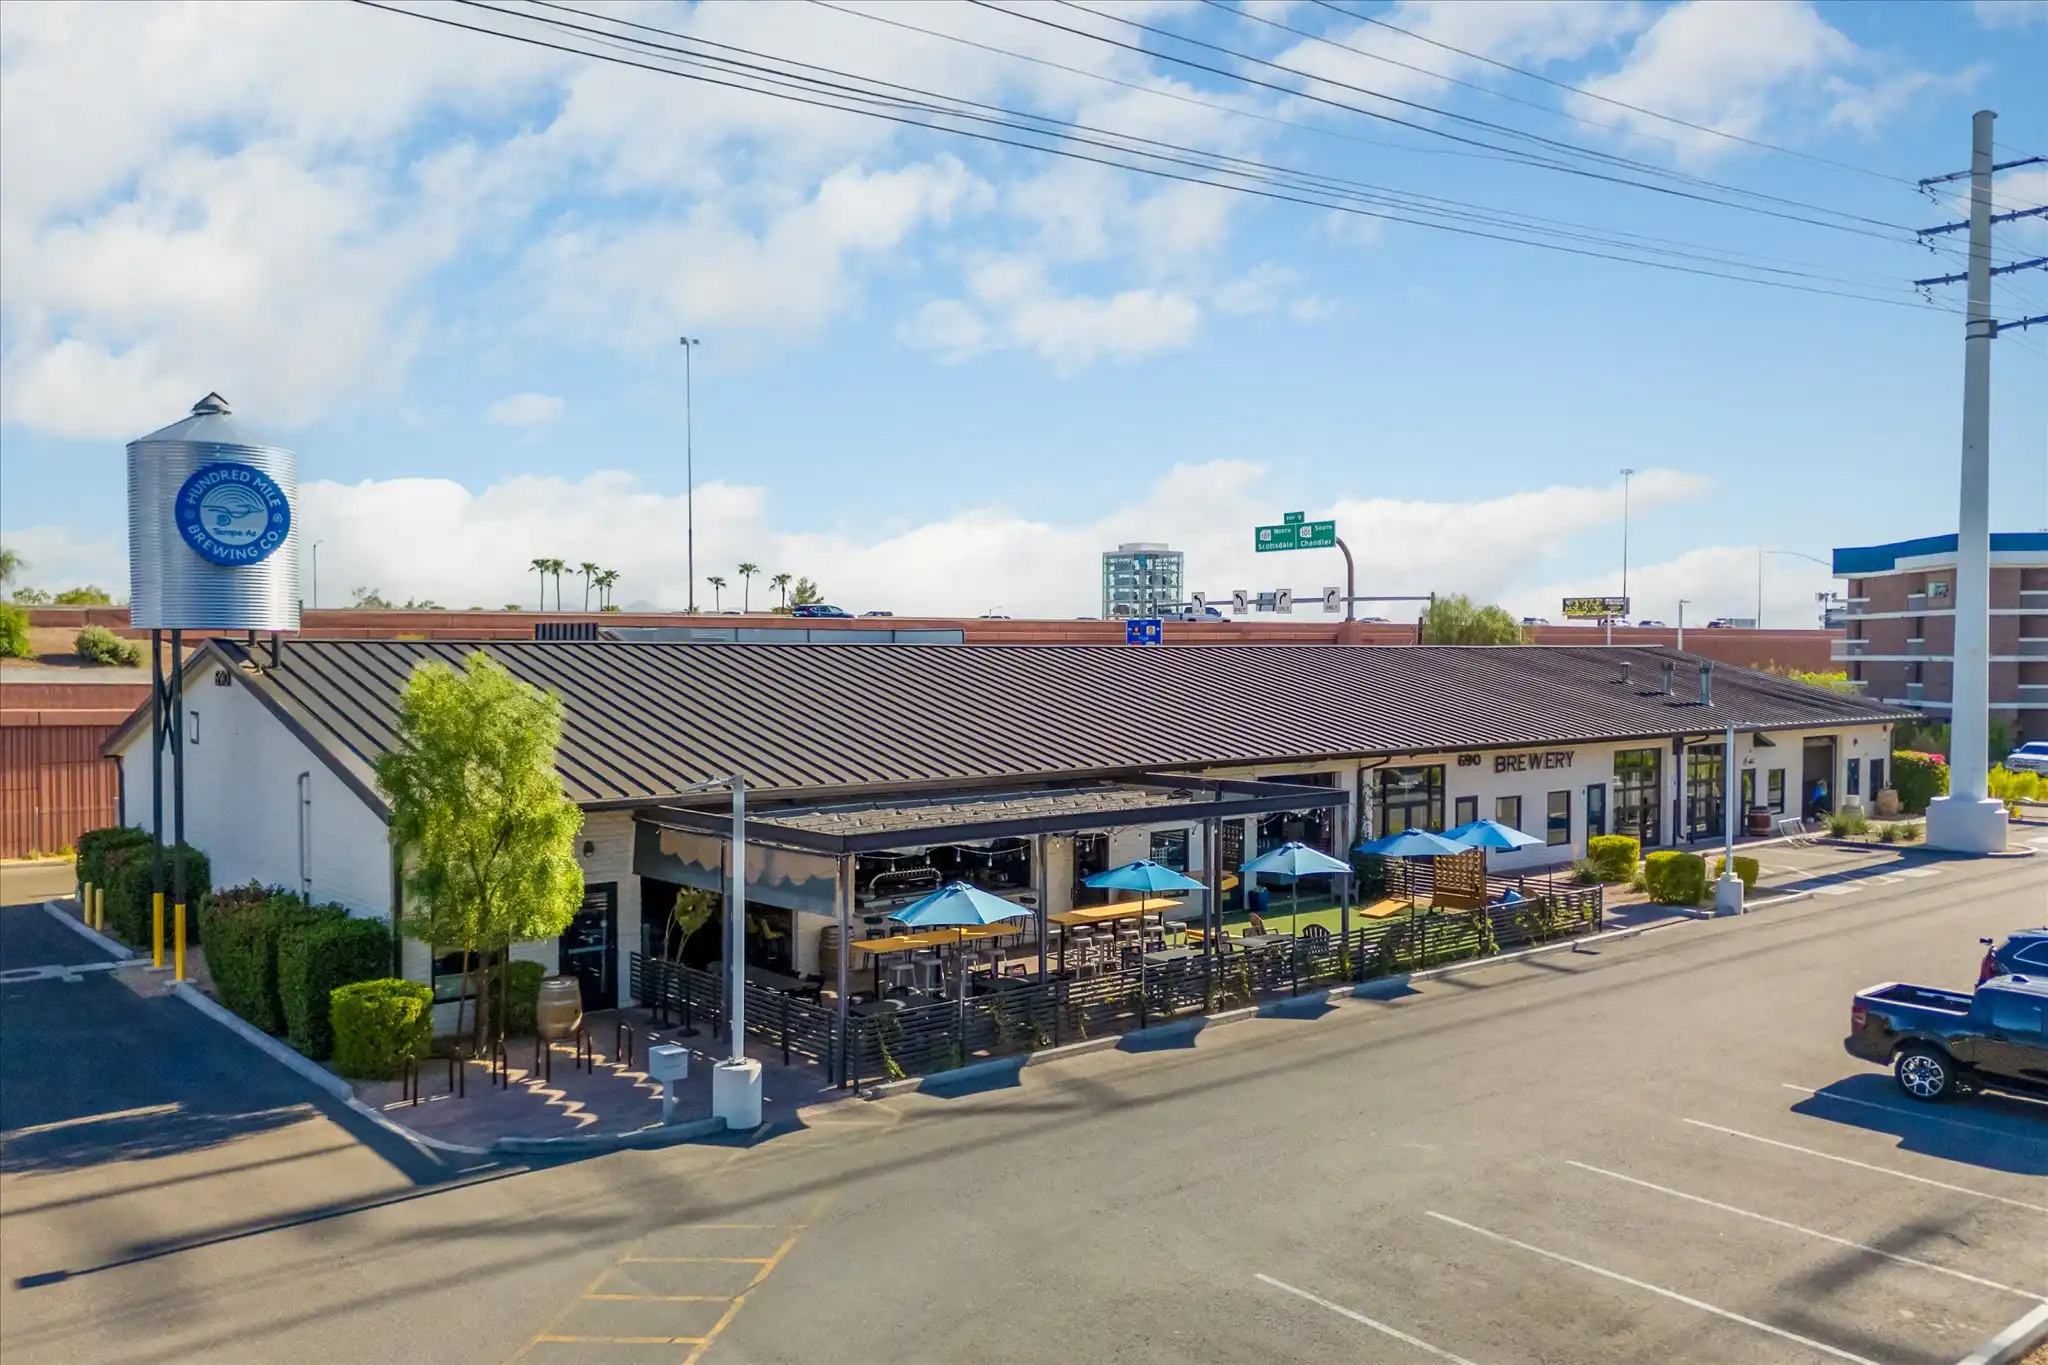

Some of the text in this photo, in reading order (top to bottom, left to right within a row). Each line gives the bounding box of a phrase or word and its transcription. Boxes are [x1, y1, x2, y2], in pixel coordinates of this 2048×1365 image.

[186, 469, 281, 508] HUNDRED MILE
[187, 523, 258, 559] BREWING
[1258, 541, 1293, 550] Scottsdale
[1300, 539, 1332, 547] Chandler
[1457, 750, 1575, 773] 690 BREWERY
